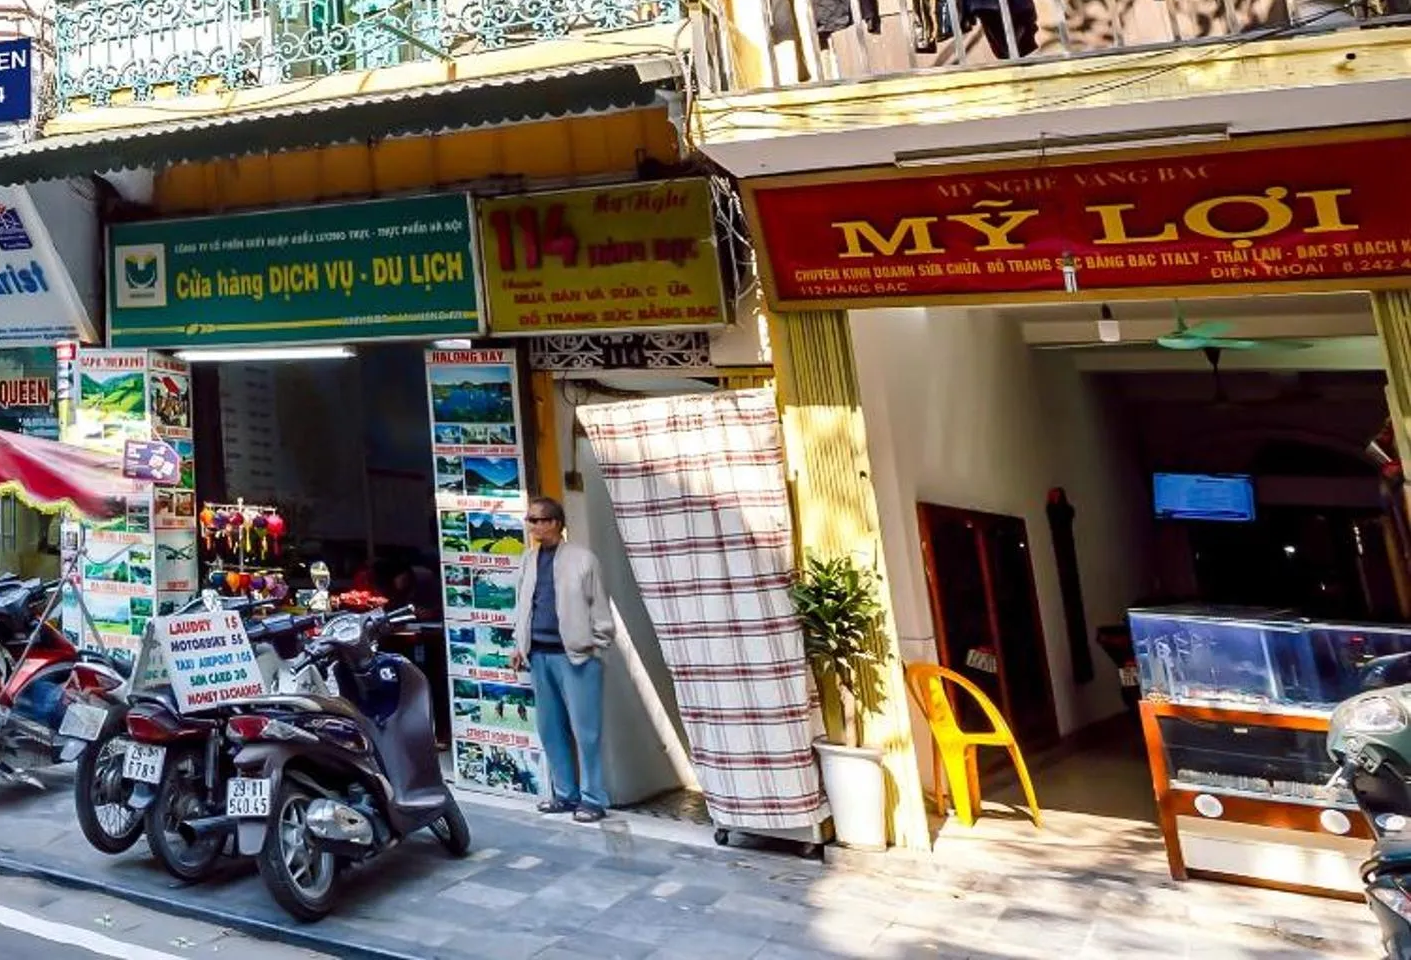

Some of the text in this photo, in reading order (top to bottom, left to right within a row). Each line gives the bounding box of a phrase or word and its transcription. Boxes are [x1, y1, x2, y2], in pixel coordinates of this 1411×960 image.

[831, 186, 1360, 258] MỸ LỢI
[490, 202, 578, 272] 114
[1056, 255, 1082, 271] SC
[1161, 251, 1200, 266] ITALY
[176, 267, 212, 299] Cửa
[217, 270, 264, 301] hàng
[269, 263, 319, 300] DỊCH
[324, 259, 355, 296] VỤ
[373, 255, 404, 286] DU
[409, 251, 464, 291] LỊCH
[547, 310, 598, 324] TRANG
[432, 350, 504, 363] HALONG BAY
[170, 619, 211, 635] LAUDRY
[187, 688, 218, 705] MONEY
